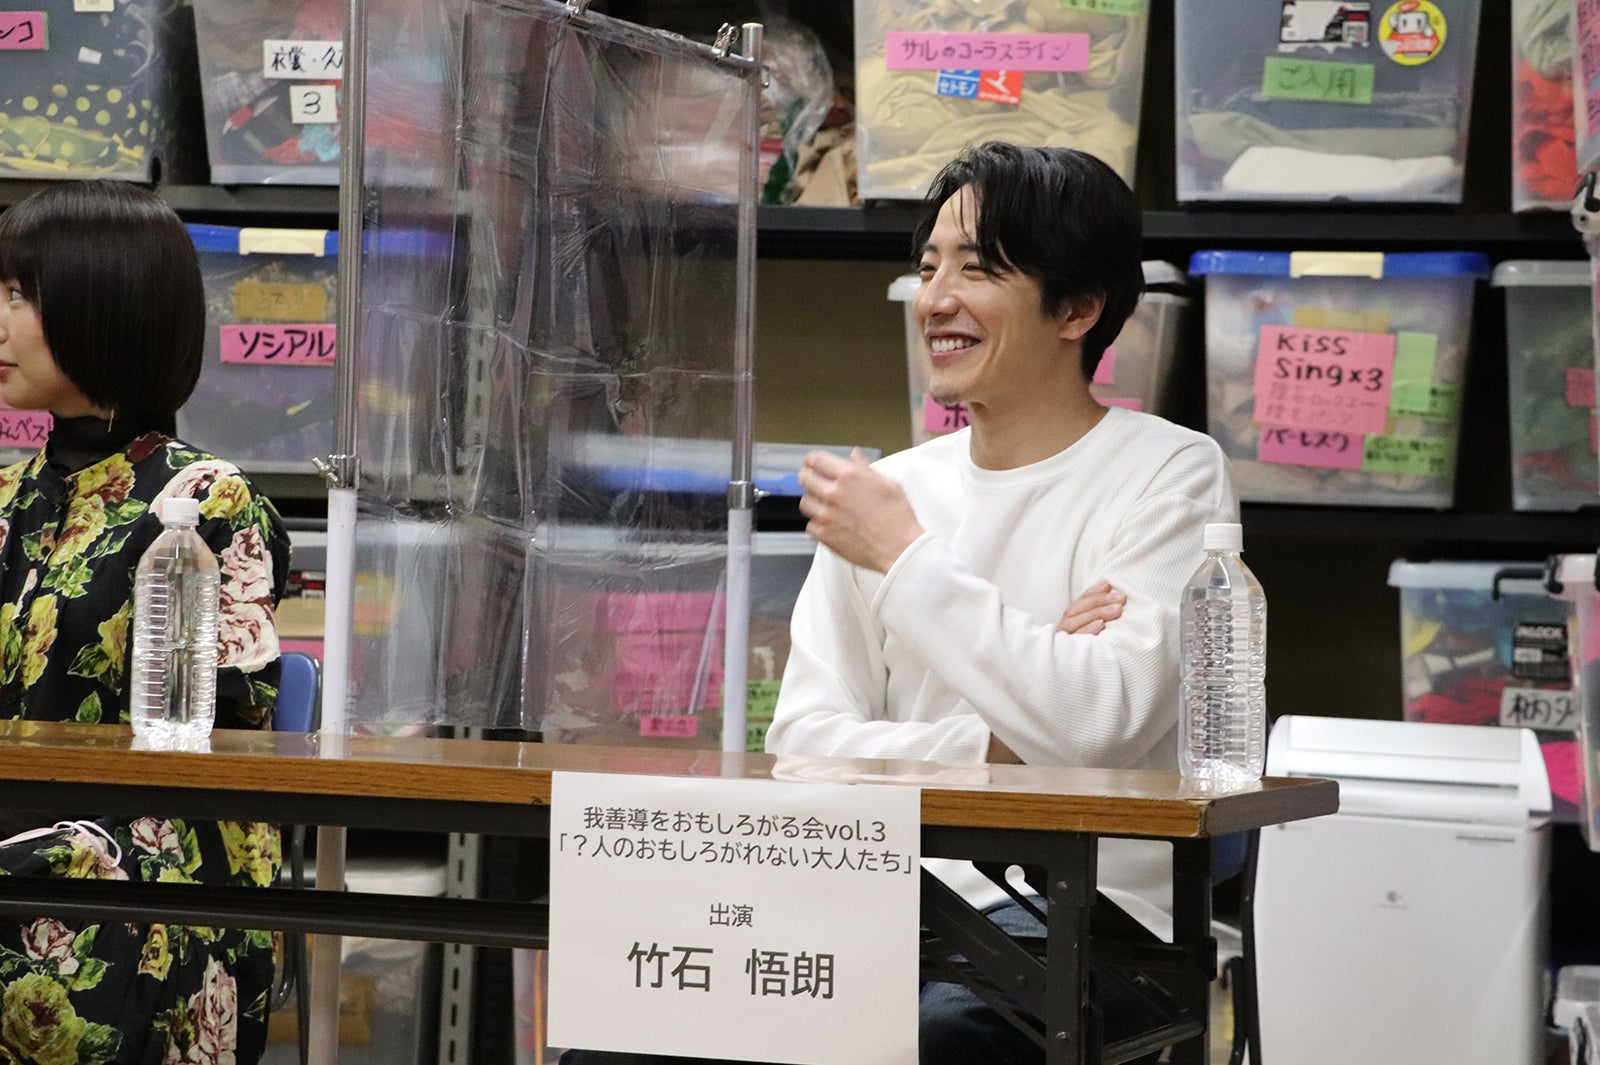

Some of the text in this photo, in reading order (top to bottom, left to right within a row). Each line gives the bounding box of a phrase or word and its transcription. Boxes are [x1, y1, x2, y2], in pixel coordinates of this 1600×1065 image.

[302, 91, 322, 115] 3
[239, 329, 335, 359] ソシアル
[583, 806, 887, 842] 我善導をおもしろがる会vol.3
[709, 902, 754, 928] 出演
[627, 941, 835, 1000] 竹石 悟朗
